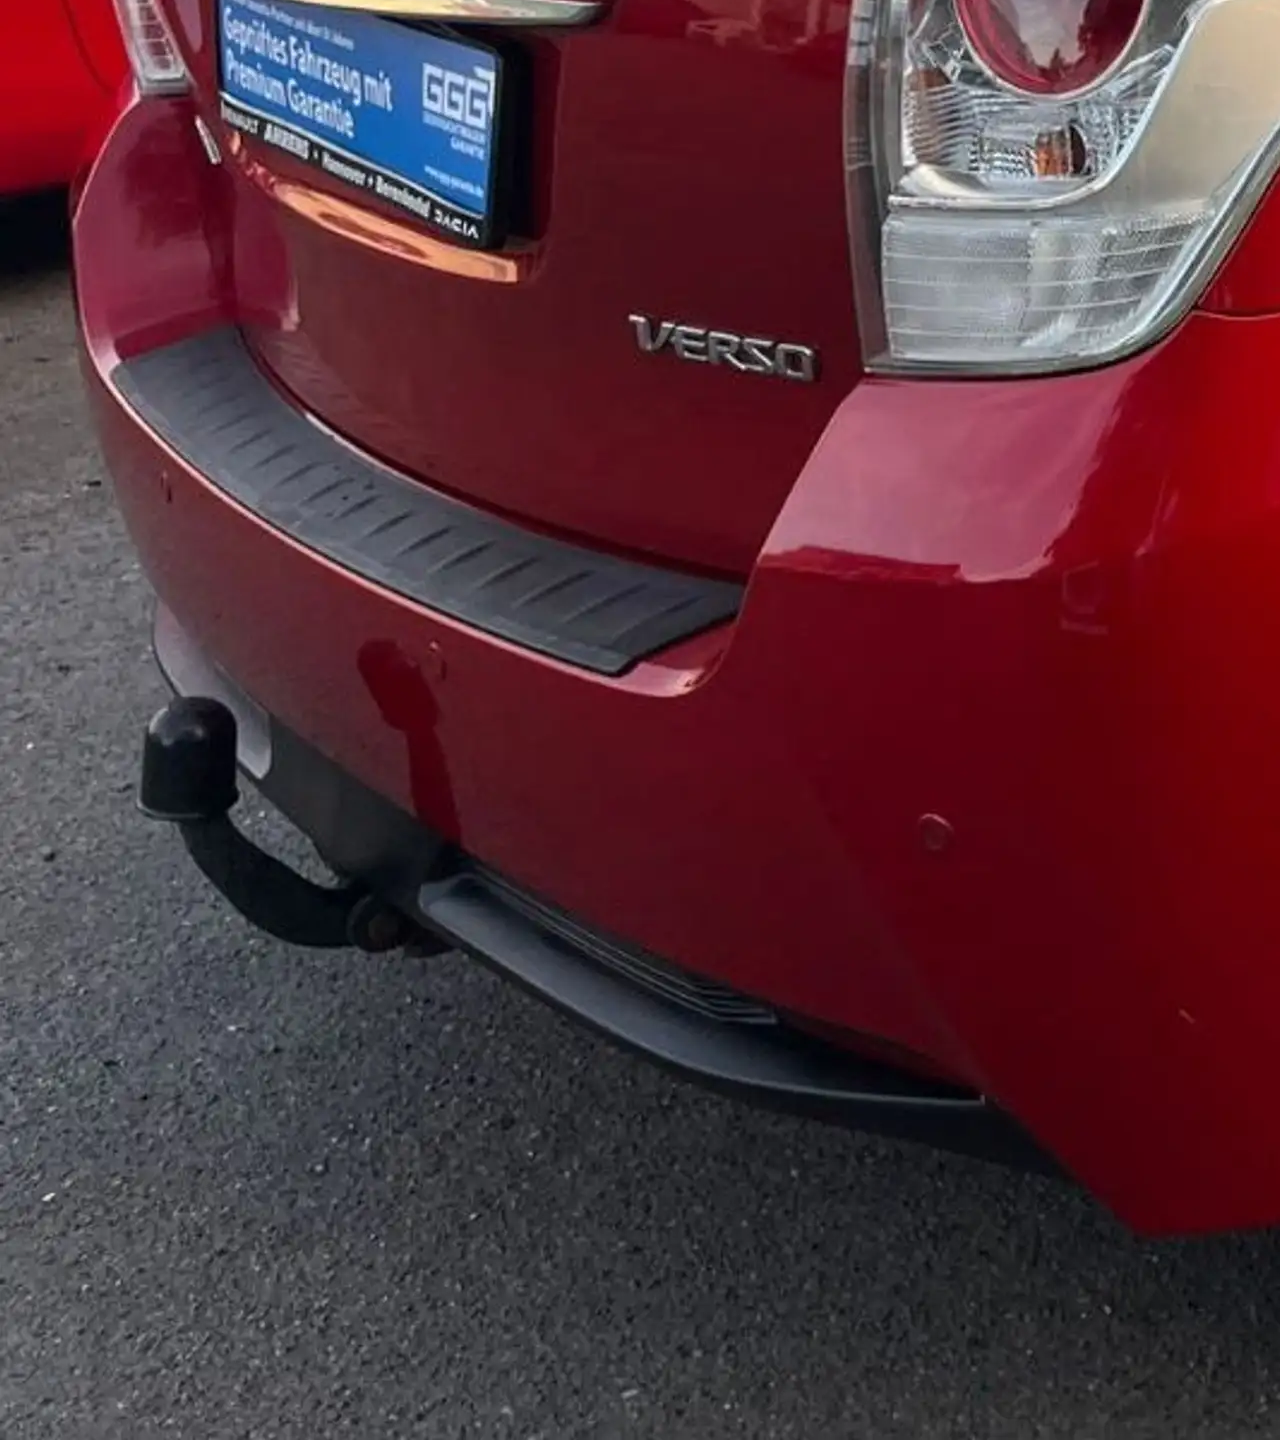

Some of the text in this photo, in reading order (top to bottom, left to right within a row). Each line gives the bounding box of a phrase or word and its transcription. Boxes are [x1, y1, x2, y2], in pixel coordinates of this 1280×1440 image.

[223, 6, 287, 67] Geprüftes
[289, 35, 361, 107] Fahrzeug
[363, 70, 393, 112] mit
[225, 47, 288, 107] Premium
[287, 78, 355, 140] Garantie
[422, 63, 488, 129] GGG
[628, 314, 815, 382] VERSO
